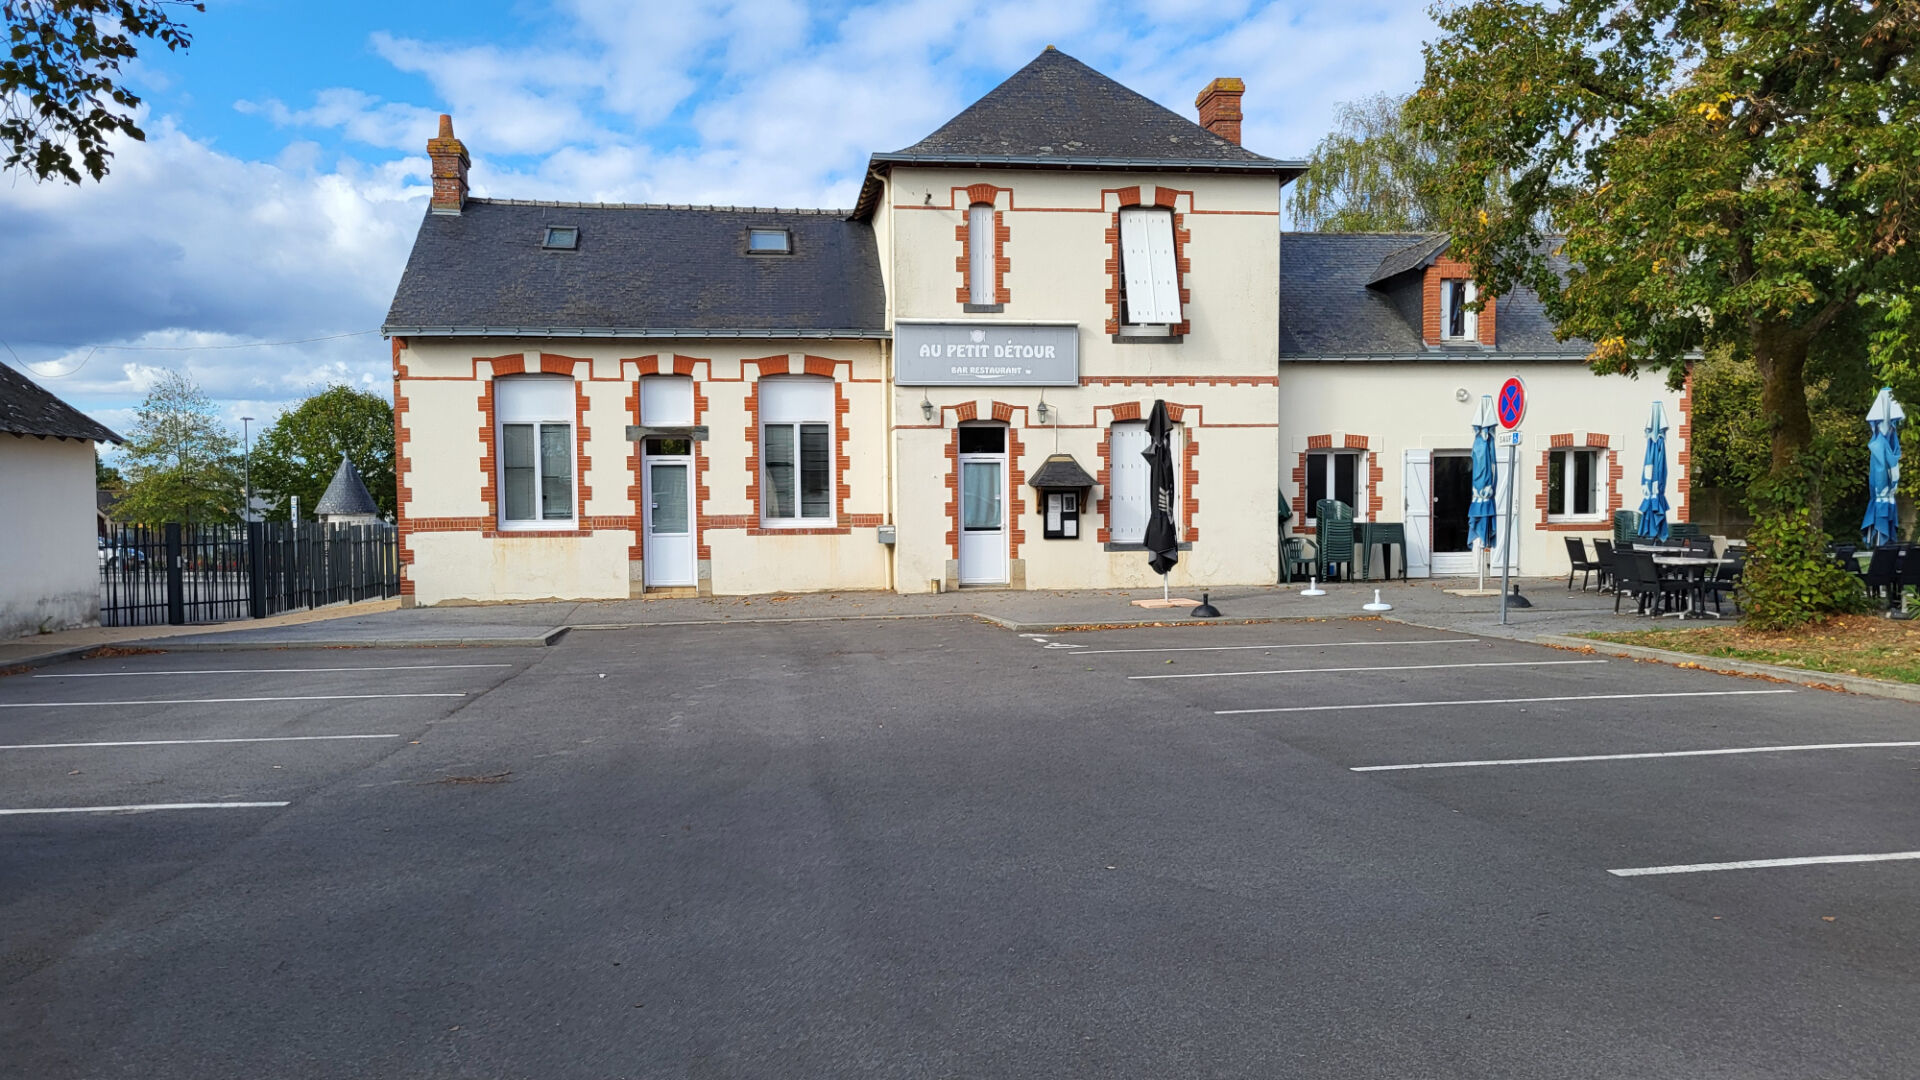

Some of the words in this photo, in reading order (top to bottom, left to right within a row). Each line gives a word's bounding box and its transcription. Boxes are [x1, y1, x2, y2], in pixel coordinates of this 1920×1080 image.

[919, 344, 942, 357] AU
[947, 344, 990, 358] PETIT
[994, 339, 1056, 358] DÉTOUR
[1499, 434, 1512, 444] SAUF
